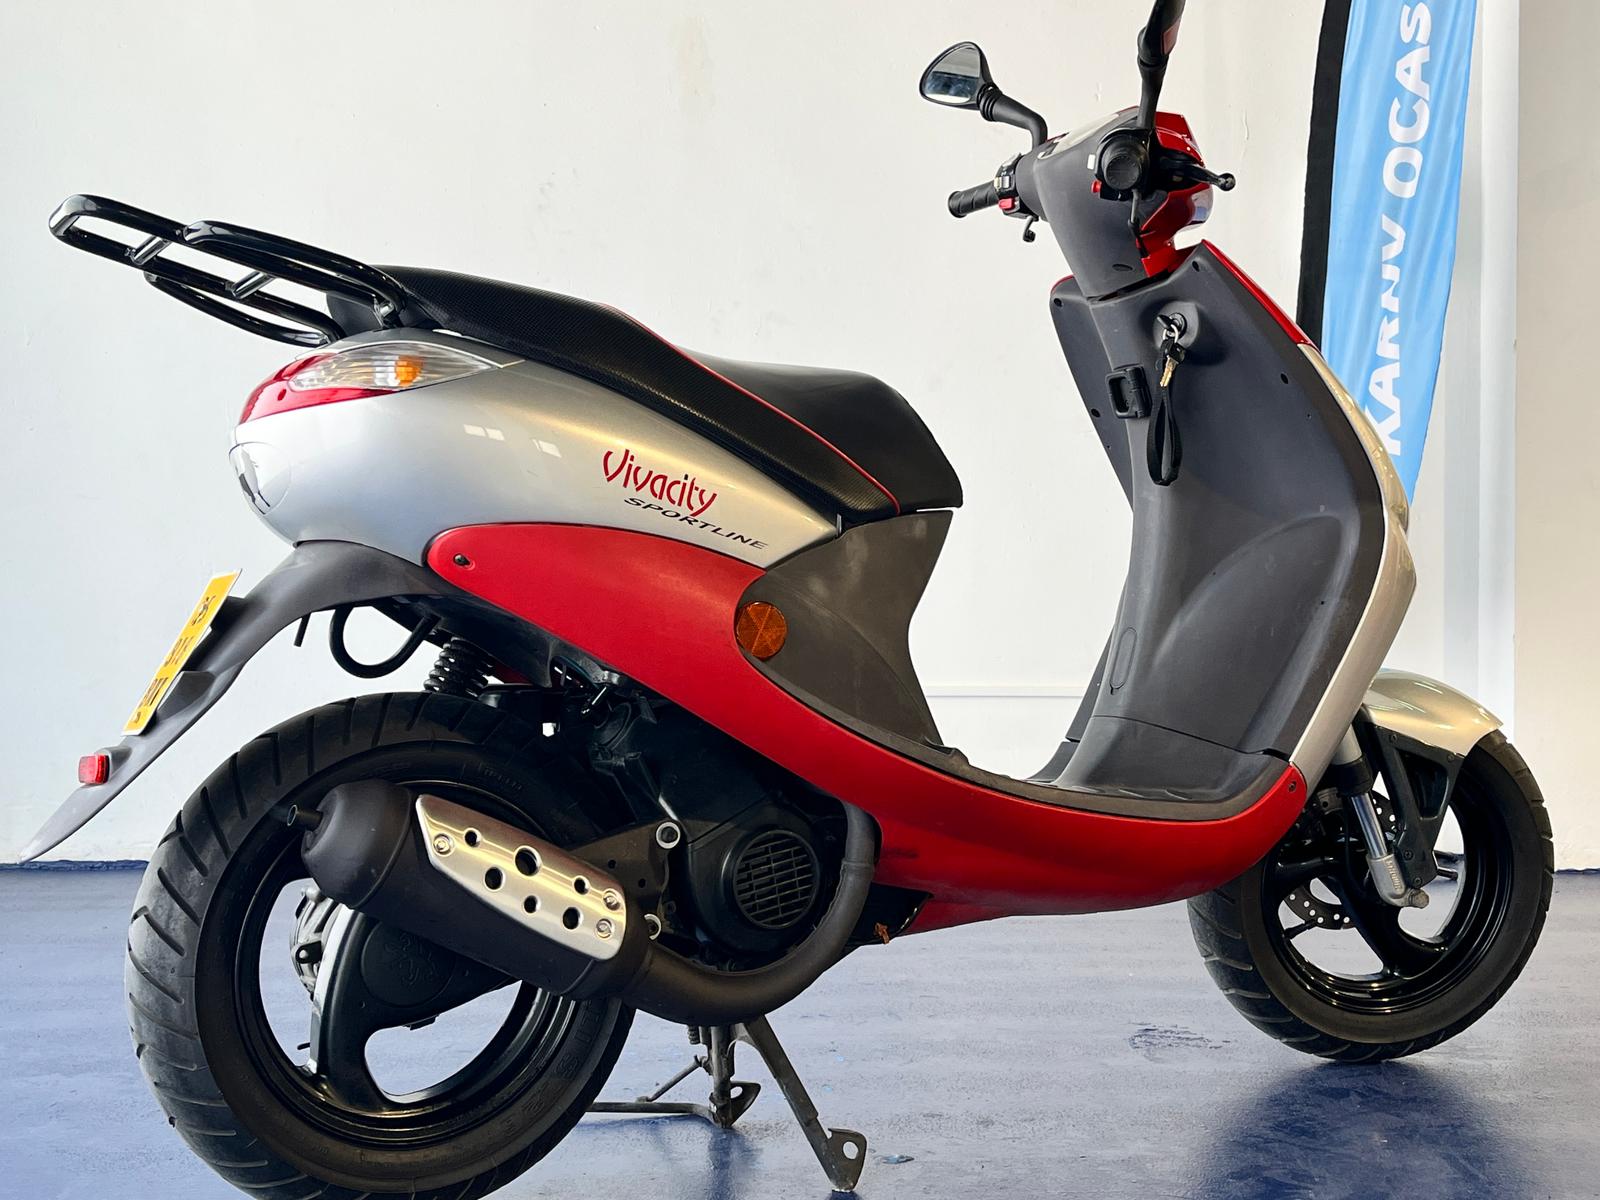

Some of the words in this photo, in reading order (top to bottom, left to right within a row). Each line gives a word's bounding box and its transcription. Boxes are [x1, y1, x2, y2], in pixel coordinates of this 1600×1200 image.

[1382, 2, 1432, 199] OCAS
[603, 449, 717, 517] Vivacity
[624, 497, 768, 550] SPORTLINE
